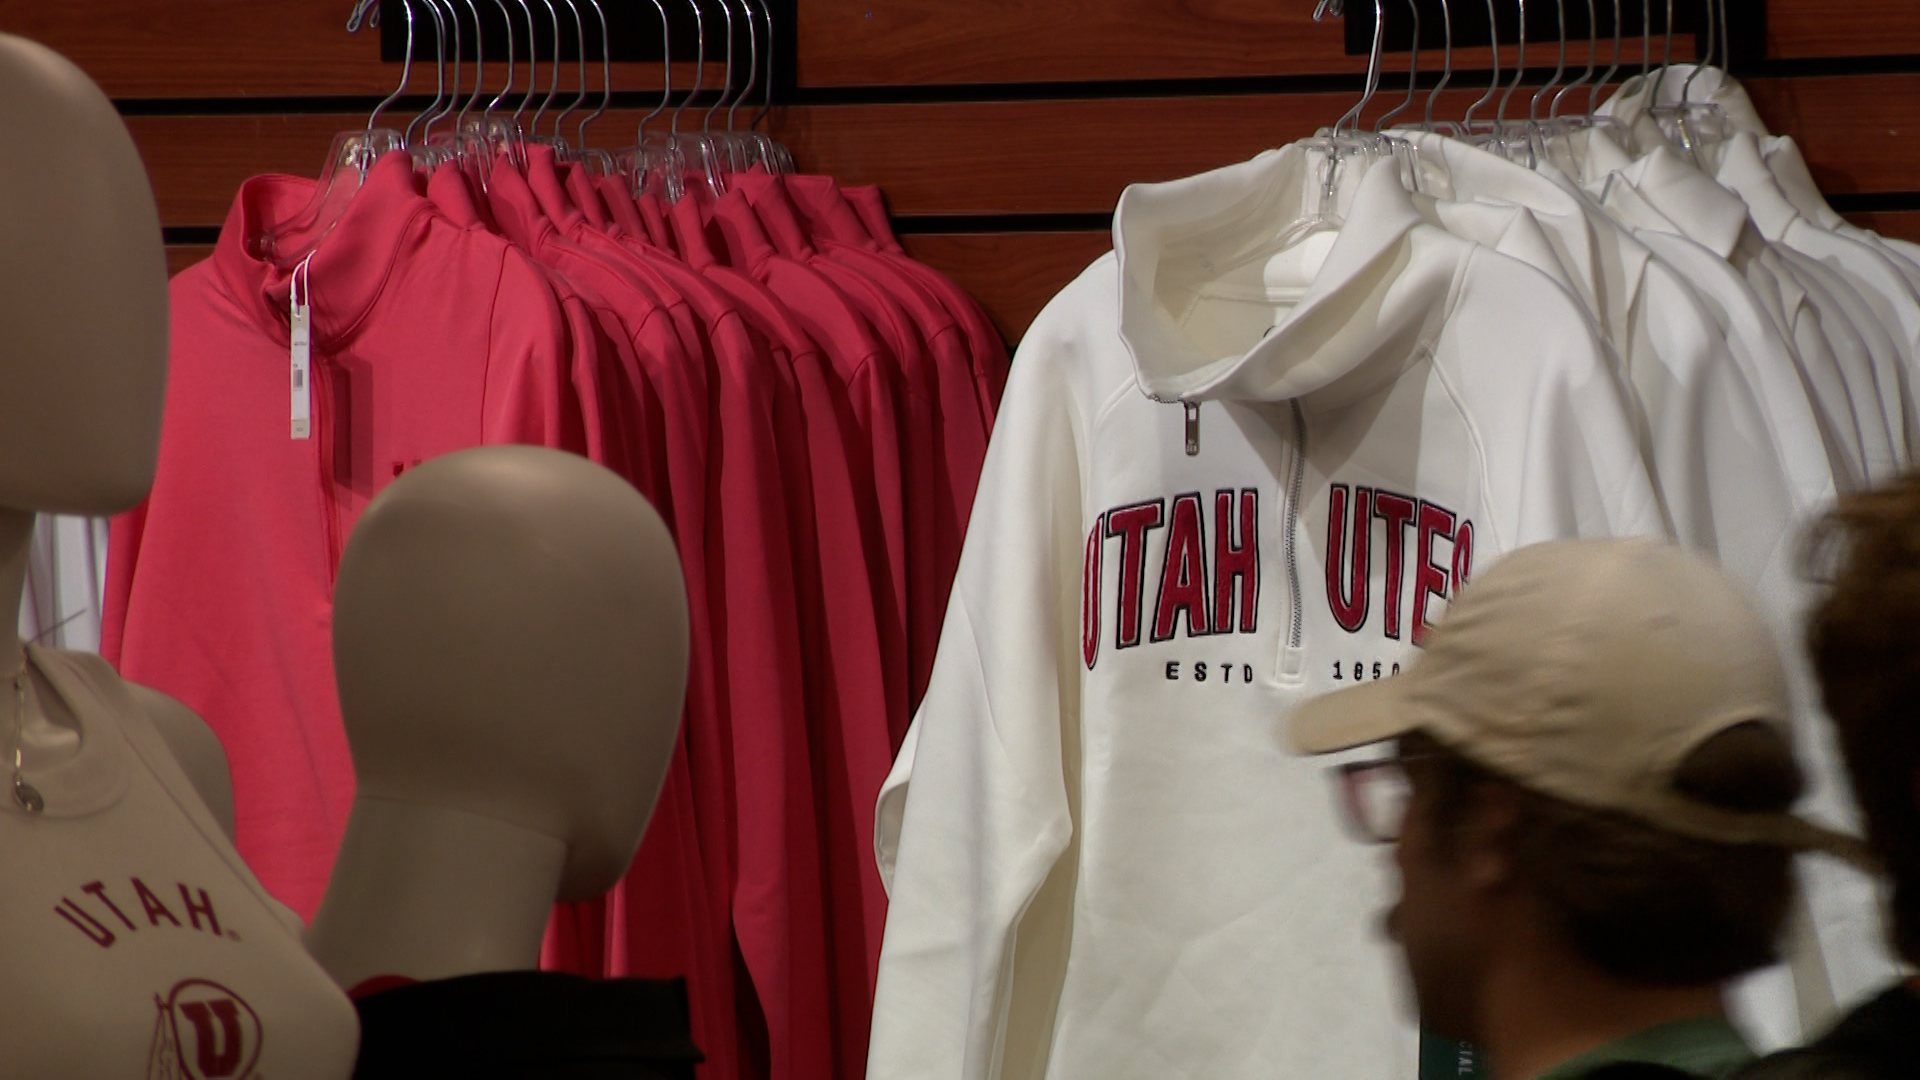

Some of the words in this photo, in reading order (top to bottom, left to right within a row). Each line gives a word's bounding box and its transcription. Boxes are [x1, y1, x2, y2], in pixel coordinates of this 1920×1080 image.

[1083, 487, 1260, 671] UTAH
[1166, 661, 1253, 684] ESTD
[1333, 660, 1400, 681] 1850
[54, 876, 222, 949] UTAH
[179, 999, 243, 1077] U
